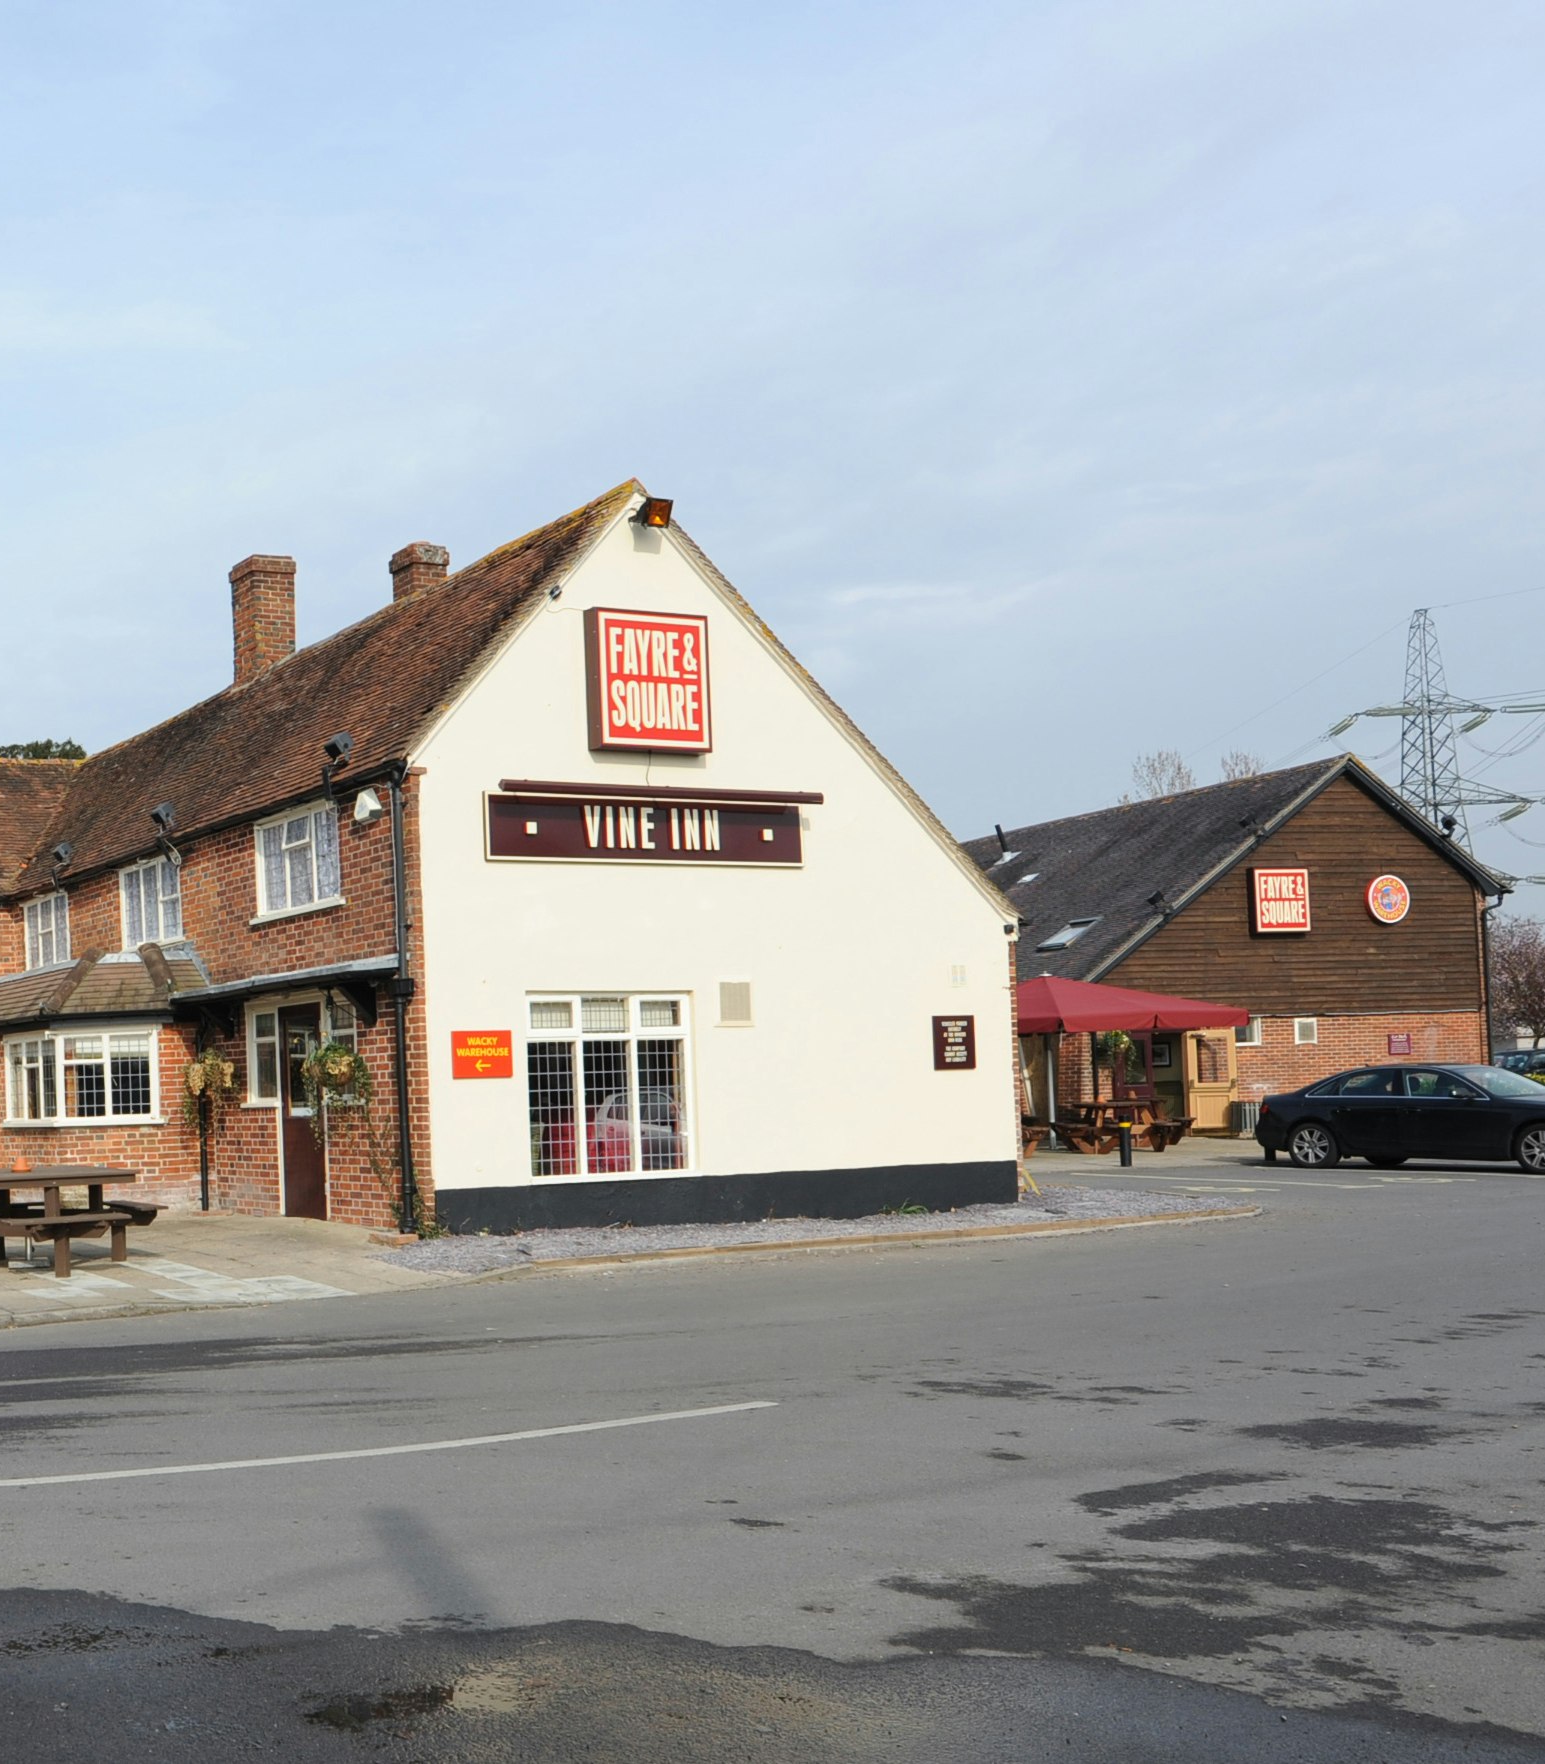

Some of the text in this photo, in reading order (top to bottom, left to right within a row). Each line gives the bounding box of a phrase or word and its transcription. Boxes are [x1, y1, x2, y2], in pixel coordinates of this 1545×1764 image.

[609, 627, 698, 679] FAYRE &
[611, 679, 699, 732] SQUARE
[582, 805, 720, 851] VINE INN
[1260, 876, 1304, 899] FAYRE &
[1377, 880, 1401, 890] WACKY
[1262, 901, 1305, 925] SQUARE
[456, 1047, 510, 1057] WAREHOUSE
[467, 1036, 498, 1046] WACKY
